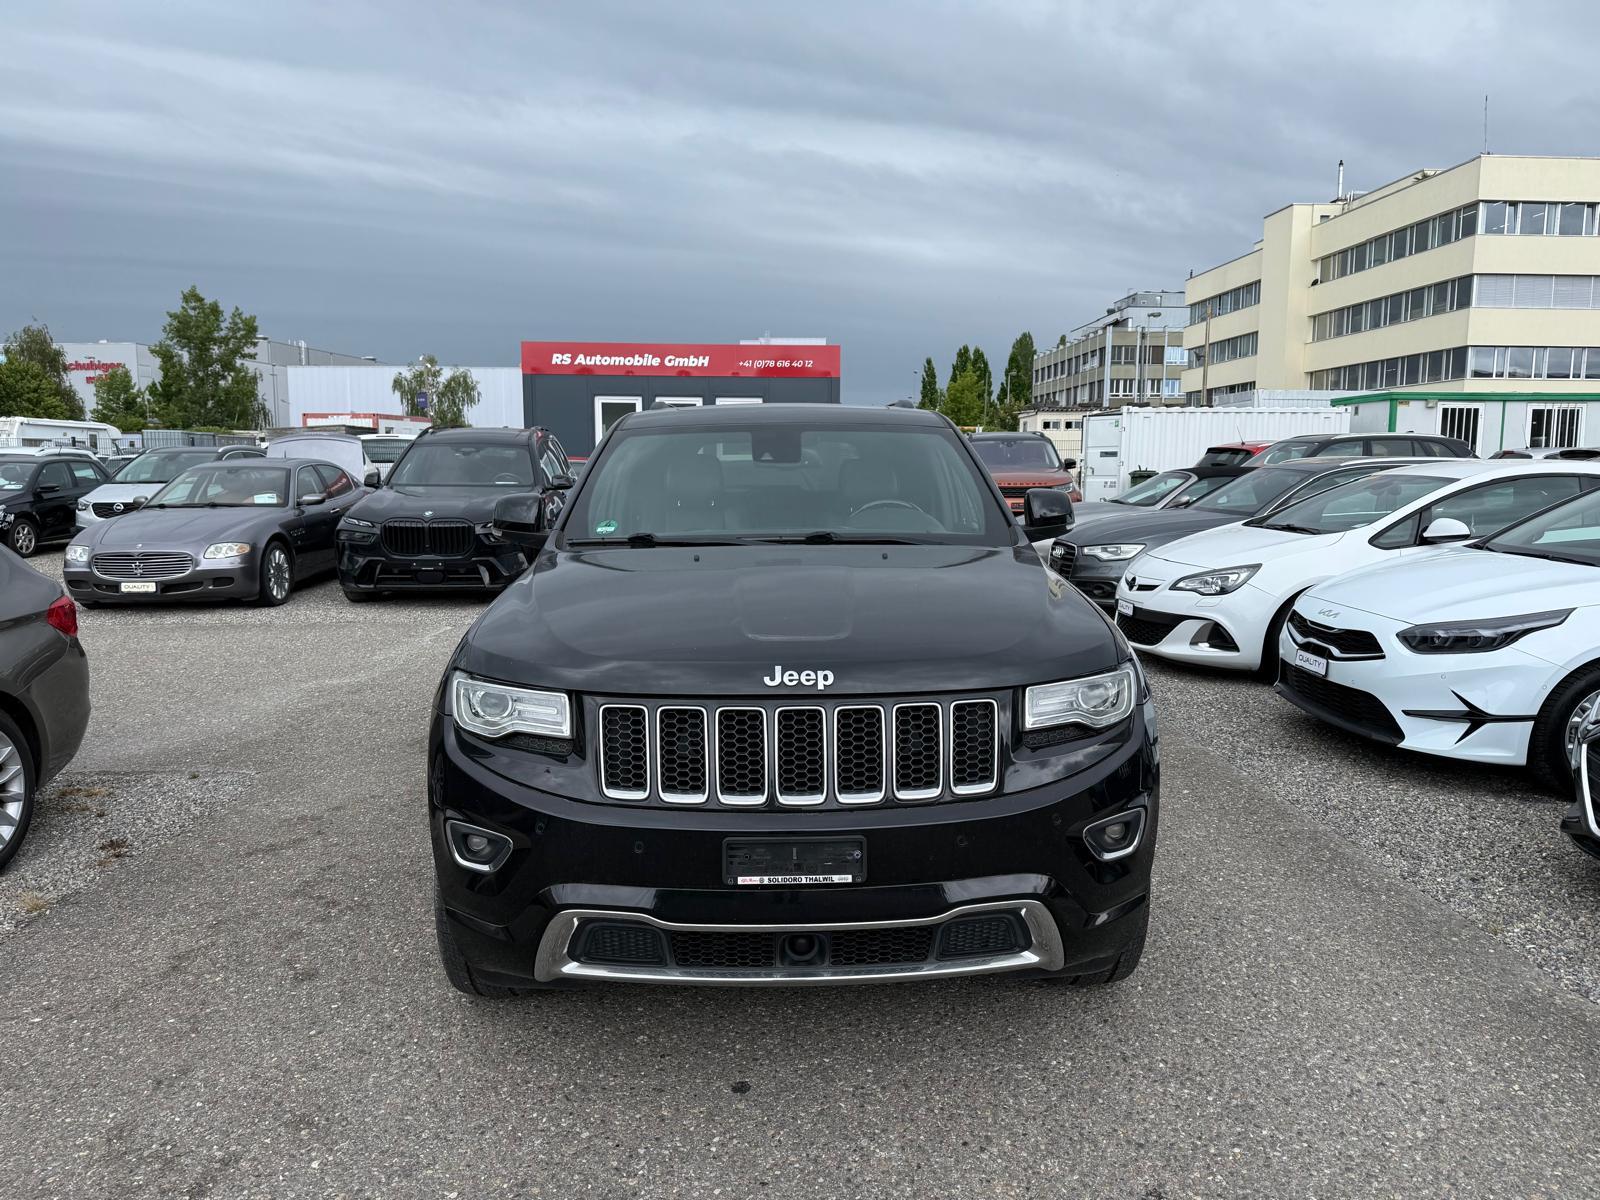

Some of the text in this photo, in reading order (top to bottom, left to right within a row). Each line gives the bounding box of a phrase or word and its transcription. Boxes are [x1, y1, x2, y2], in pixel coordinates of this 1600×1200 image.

[64, 360, 122, 372] chubiger
[551, 353, 710, 367] RS Automobile GmbH
[738, 359, 814, 369] +41 (0)78 616 40 12
[763, 665, 834, 690] Jeep
[767, 876, 802, 884] SOLIDORO
[804, 875, 835, 883] THALWIL
